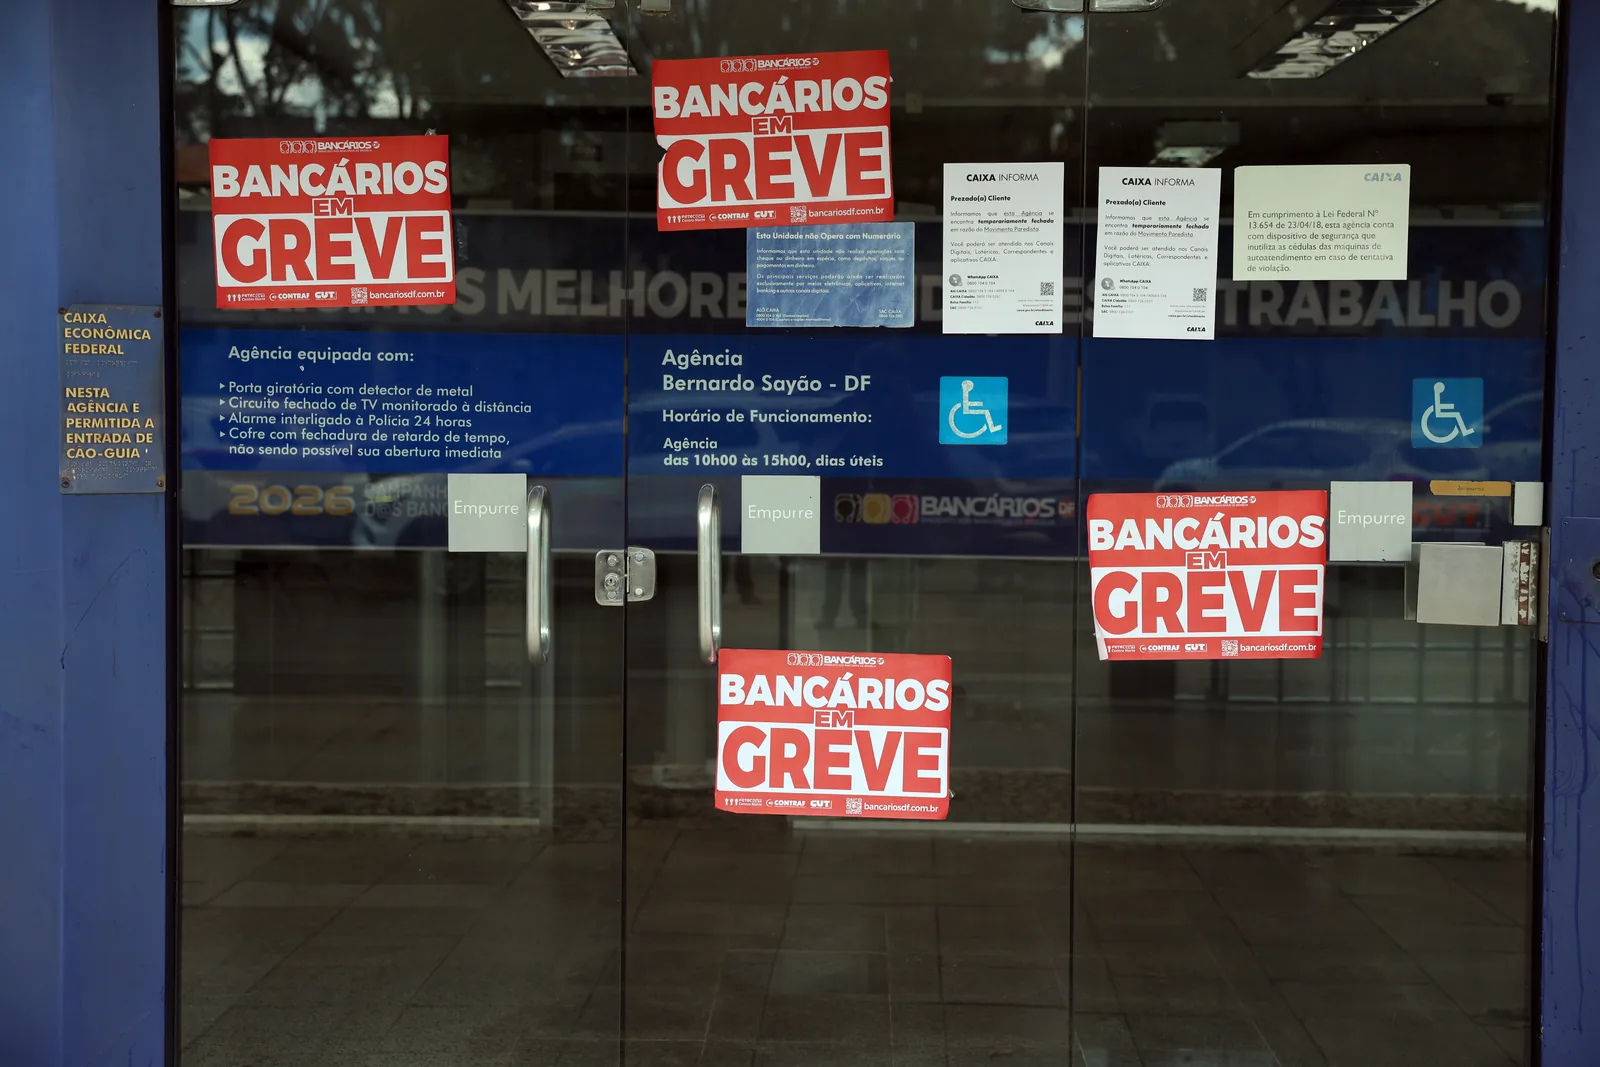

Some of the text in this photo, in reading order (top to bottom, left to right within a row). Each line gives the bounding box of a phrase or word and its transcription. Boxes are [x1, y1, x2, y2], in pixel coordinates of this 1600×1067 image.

[758, 58, 811, 69] BANCÁRIOS
[654, 75, 888, 119] BANCÁRIOS
[753, 117, 791, 134] EM
[318, 140, 371, 150] BANCÁRIOS
[663, 132, 886, 204] GREVE
[213, 158, 447, 197] BANCÁRIOS
[1364, 173, 1402, 182] CAIXA
[314, 199, 352, 216] EM
[808, 207, 884, 217] bancariosdf.com.br
[1263, 211, 1314, 219] cumprimento
[1343, 221, 1370, 230] agência
[821, 232, 844, 240] Opera
[1267, 232, 1307, 241] dispositivo
[1322, 232, 1358, 241] segurança
[222, 216, 446, 283] GREVE
[1334, 243, 1369, 251] máquinas
[1259, 265, 1291, 273] violação.
[370, 290, 445, 300] bancariosdf.com.br
[497, 269, 746, 319] MELHORE
[1216, 278, 1521, 328] TRABALHO
[64, 313, 107, 323] CAIXA
[64, 326, 151, 339] ECONÔMICA
[65, 344, 124, 354] FEDERAL
[228, 346, 414, 364] Agência equipada com:
[662, 349, 743, 369] Agência
[229, 382, 473, 396] Porta giratória com detector de metal
[663, 374, 754, 391] Bernardo
[761, 374, 822, 395] Sayão
[845, 375, 871, 391] DF
[66, 388, 110, 398] NESTA
[67, 400, 128, 412] AGÊNCIA
[229, 397, 532, 413] Circuito fechado de TV monitorado à distância
[66, 418, 154, 428] PERMITIDA A
[229, 413, 472, 428] Alarme interligado à Polícia 24 horas
[662, 409, 872, 423] Horário de Funcionamento:
[66, 433, 152, 443] ENTRADA DE
[229, 428, 510, 445] Cofre com fechadura de retardo de tempo,
[663, 437, 717, 451] Agência
[66, 446, 140, 459] CÃO-GUIA
[229, 444, 502, 459] não sendo possível sua abertura imediata
[664, 454, 883, 468] das 10h00 às 15h00, dias úteis
[364, 482, 448, 500] CAMPANH
[229, 485, 355, 515] 2026
[921, 493, 1056, 518] BANCÁRIOS
[1194, 495, 1248, 504] BANCÁRIOS
[454, 500, 519, 518] Empurre
[748, 504, 813, 522] Empurre
[1338, 510, 1405, 528] Empurre
[1090, 512, 1324, 551] BANCÁRIOS
[1187, 552, 1226, 569] EM
[1094, 570, 1318, 635] GREVE
[1240, 644, 1316, 652] bancariosdf.com.br
[824, 655, 876, 665] BANCÁRIOS
[720, 672, 949, 711] BANCÁRIOS
[815, 711, 853, 728] EM
[723, 725, 941, 793] GREVE
[864, 802, 938, 812] bancariosdf.com.br
